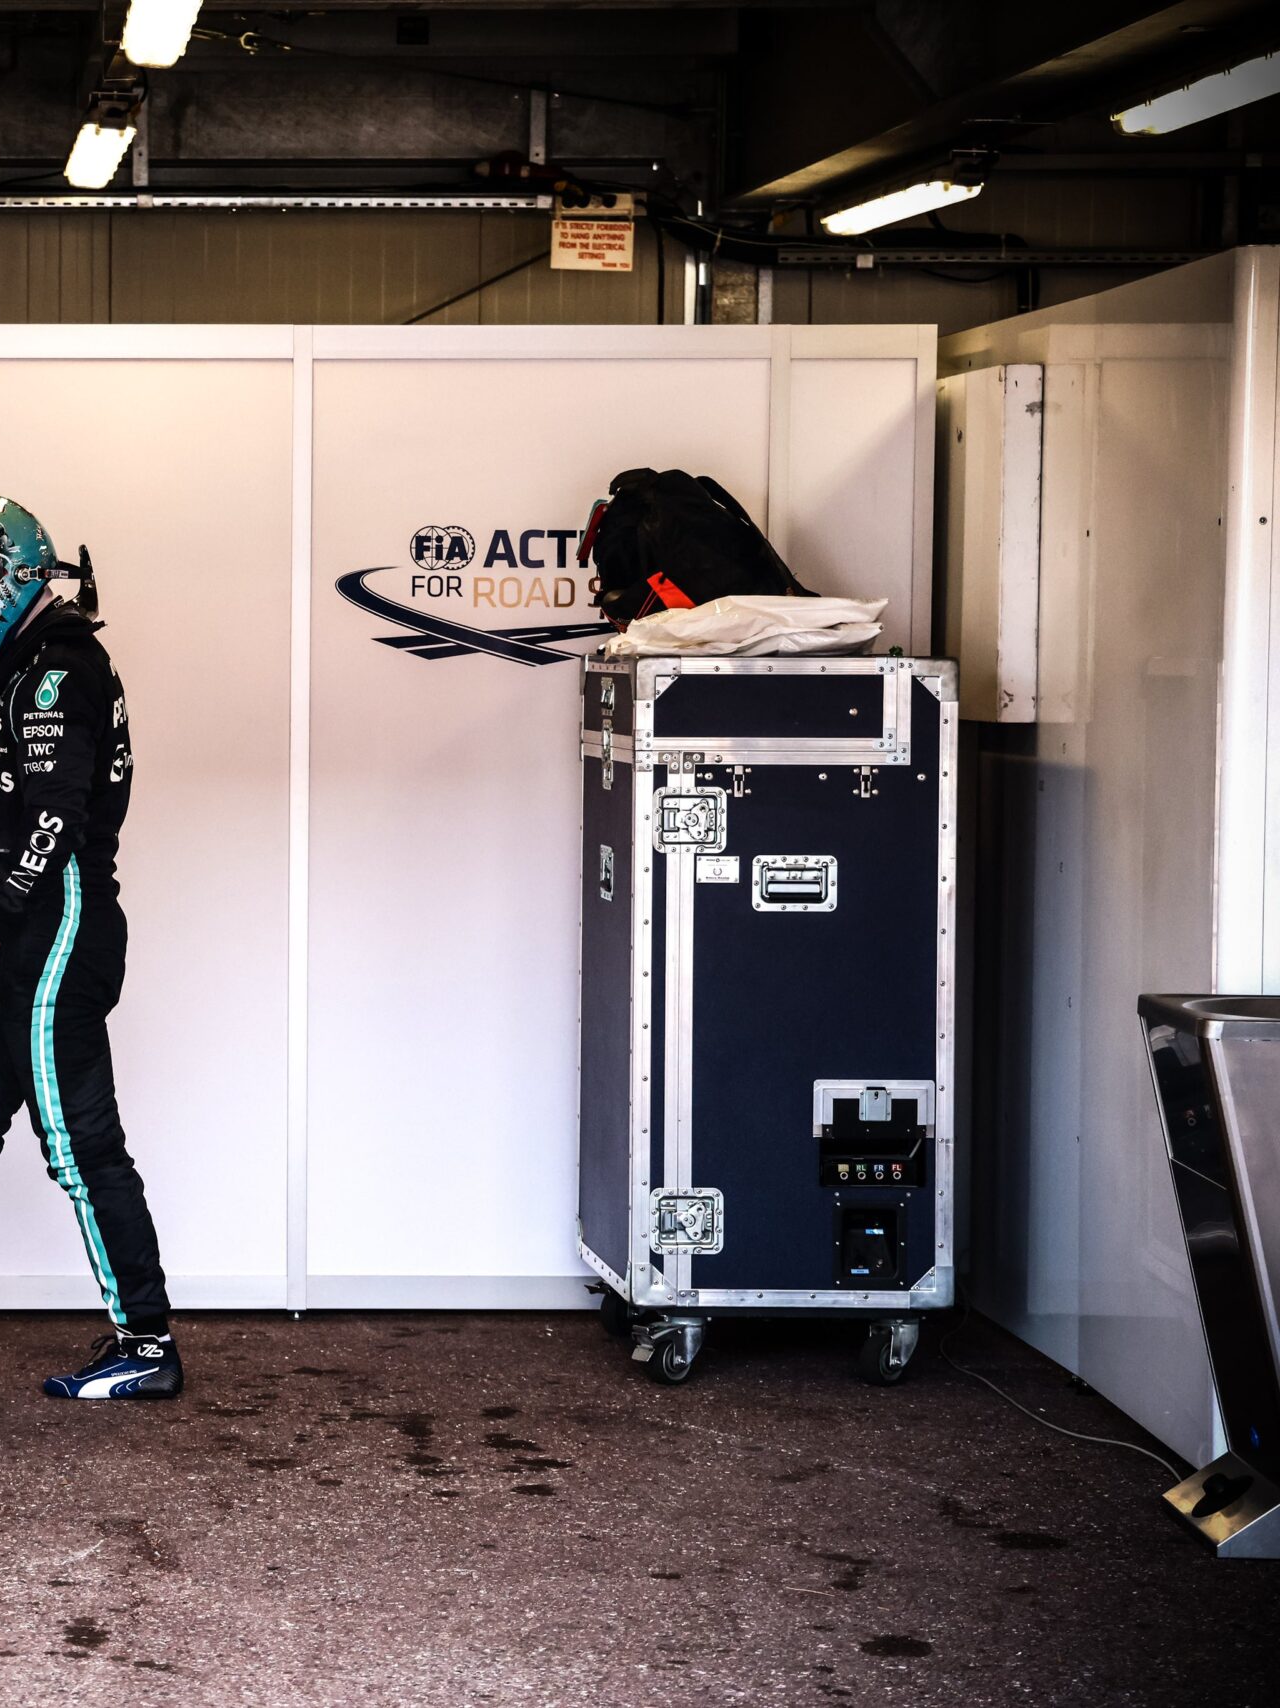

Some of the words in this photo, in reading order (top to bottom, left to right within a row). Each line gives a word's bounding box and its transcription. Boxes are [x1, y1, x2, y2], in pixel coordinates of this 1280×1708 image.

[596, 223, 632, 231] FORBIDDEN
[592, 233, 625, 241] ANYTHING
[559, 241, 577, 249] FROM
[592, 242, 625, 251] ELECTRICAL
[412, 576, 463, 597] FOR
[473, 577, 576, 608] ROAD
[23, 711, 64, 720] PETRONAS
[23, 725, 64, 739] EPSON
[28, 743, 55, 757] IWC
[6, 810, 64, 894] INEOS
